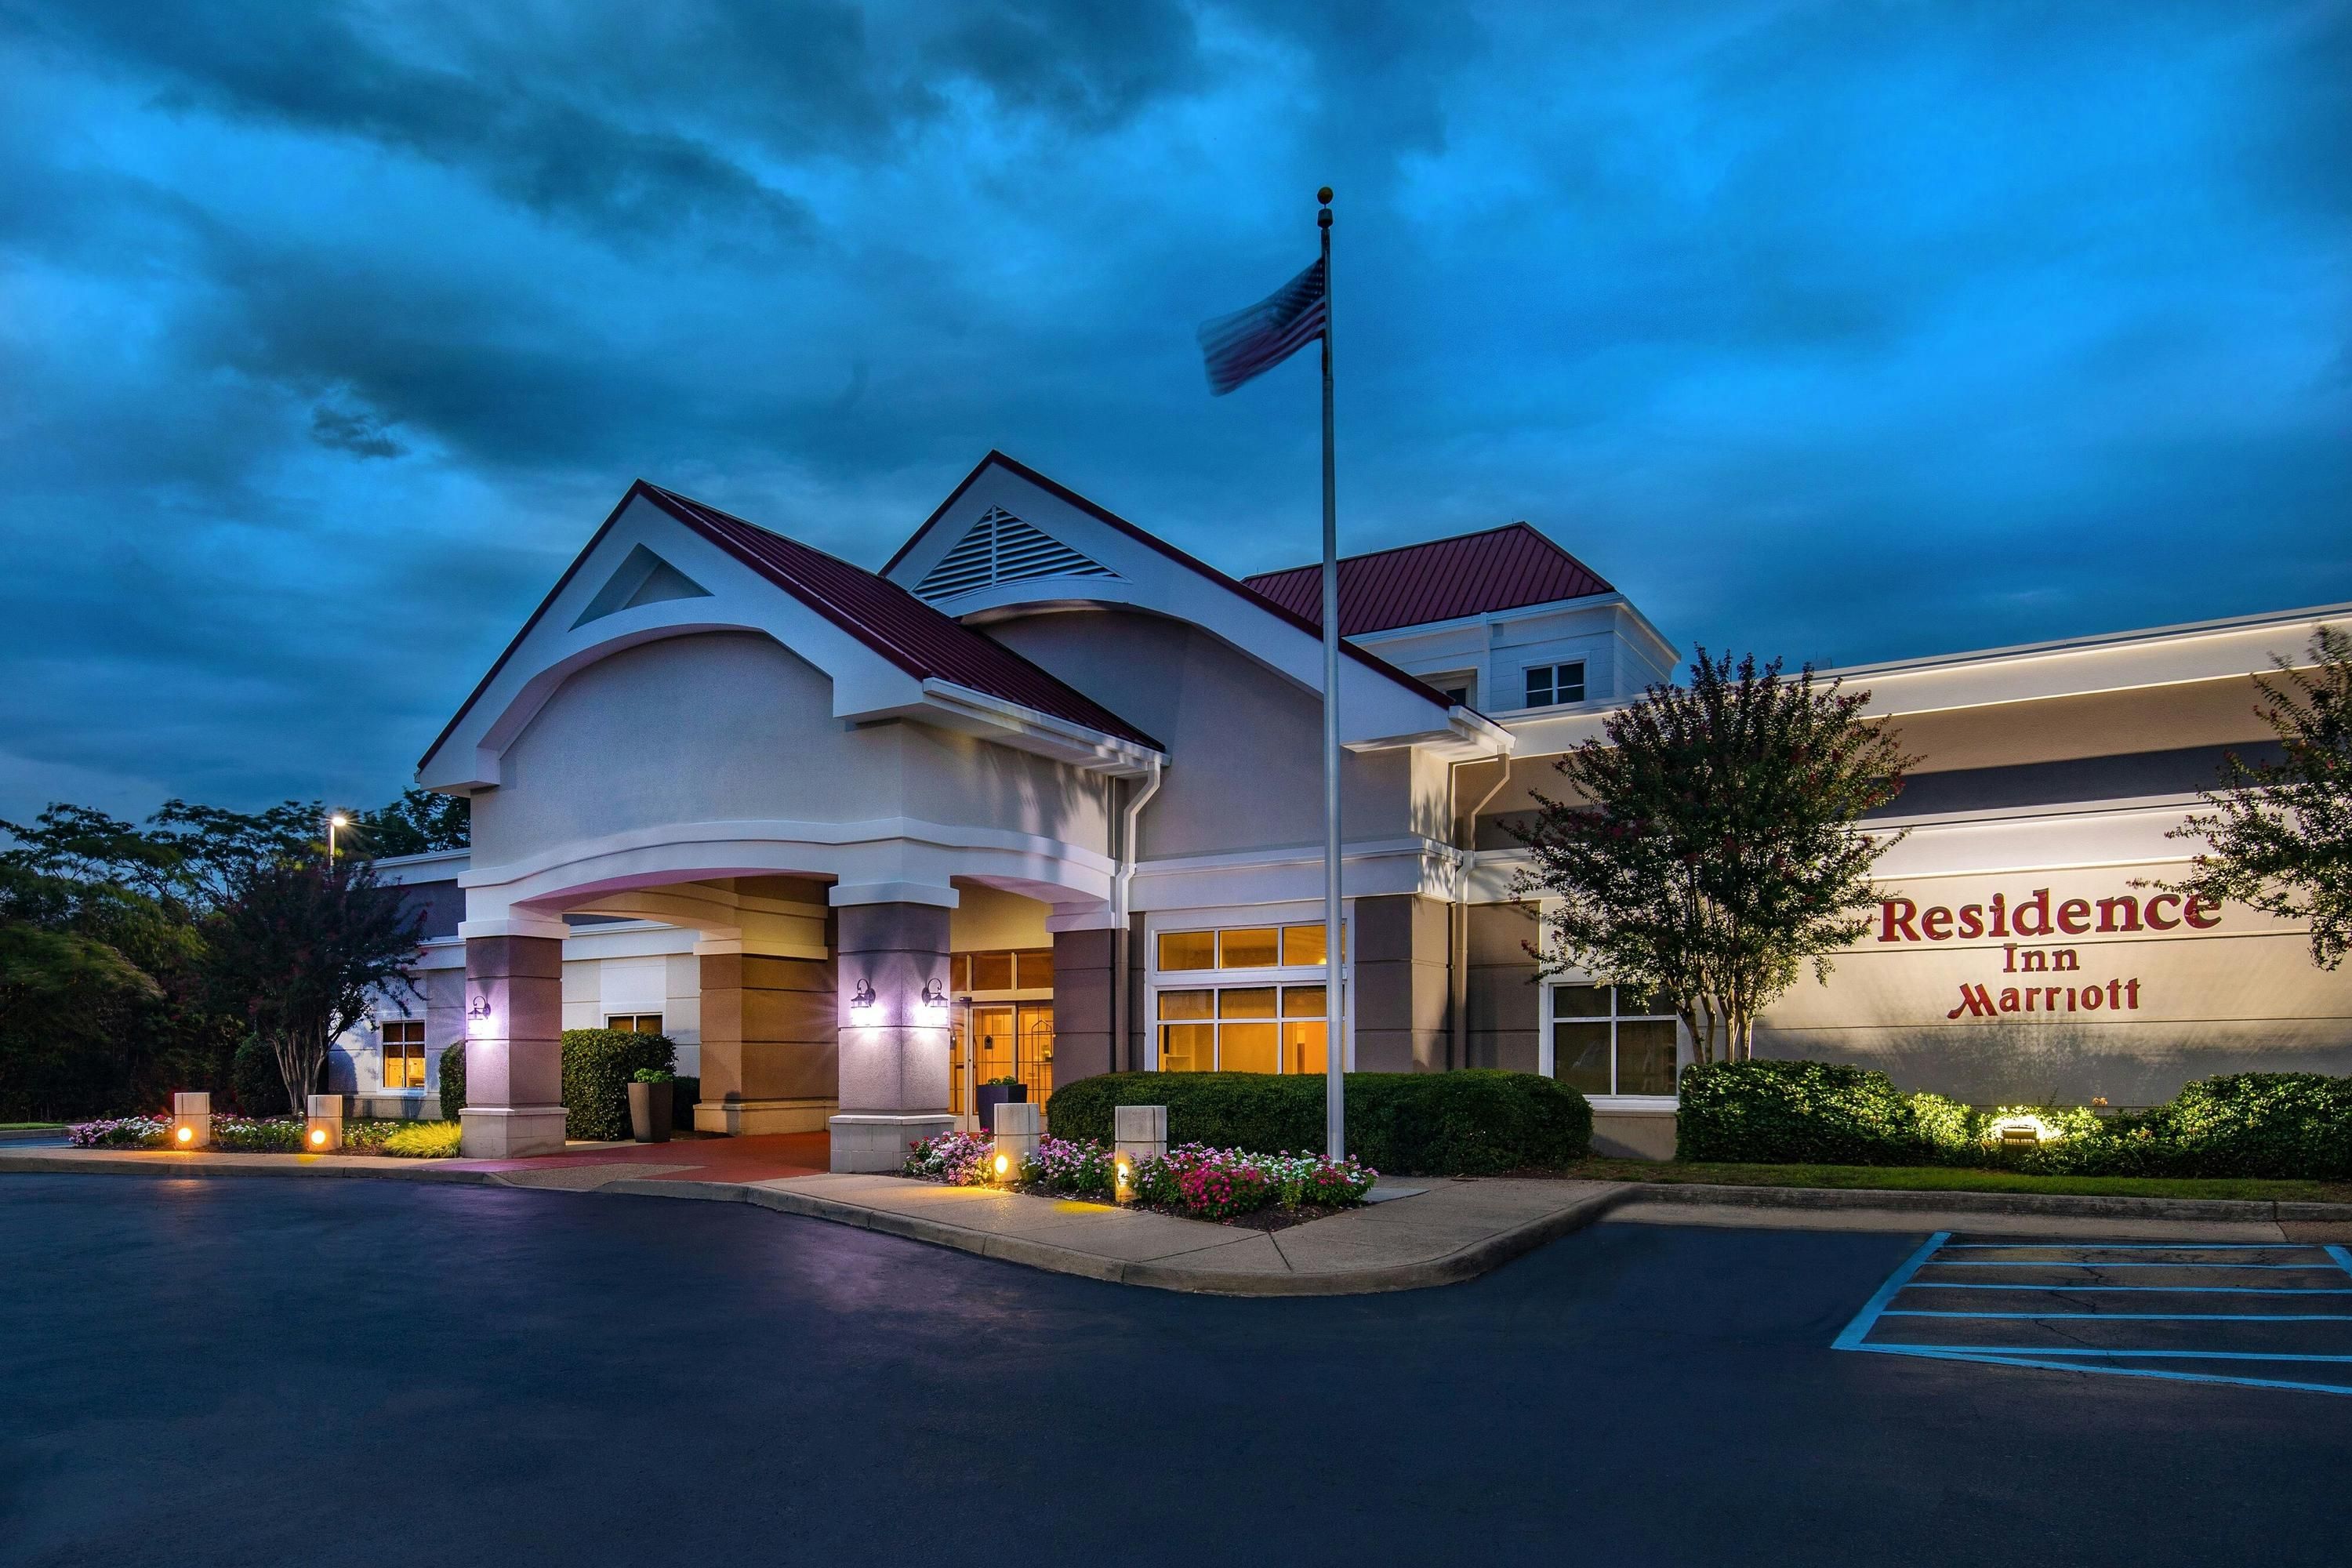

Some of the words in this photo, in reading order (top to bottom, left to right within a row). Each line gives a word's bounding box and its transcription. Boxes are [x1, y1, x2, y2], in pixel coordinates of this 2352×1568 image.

[1877, 887, 2223, 942] Residence
[2002, 943, 2080, 973] Inn
[1947, 978, 2141, 1019] Marriott
